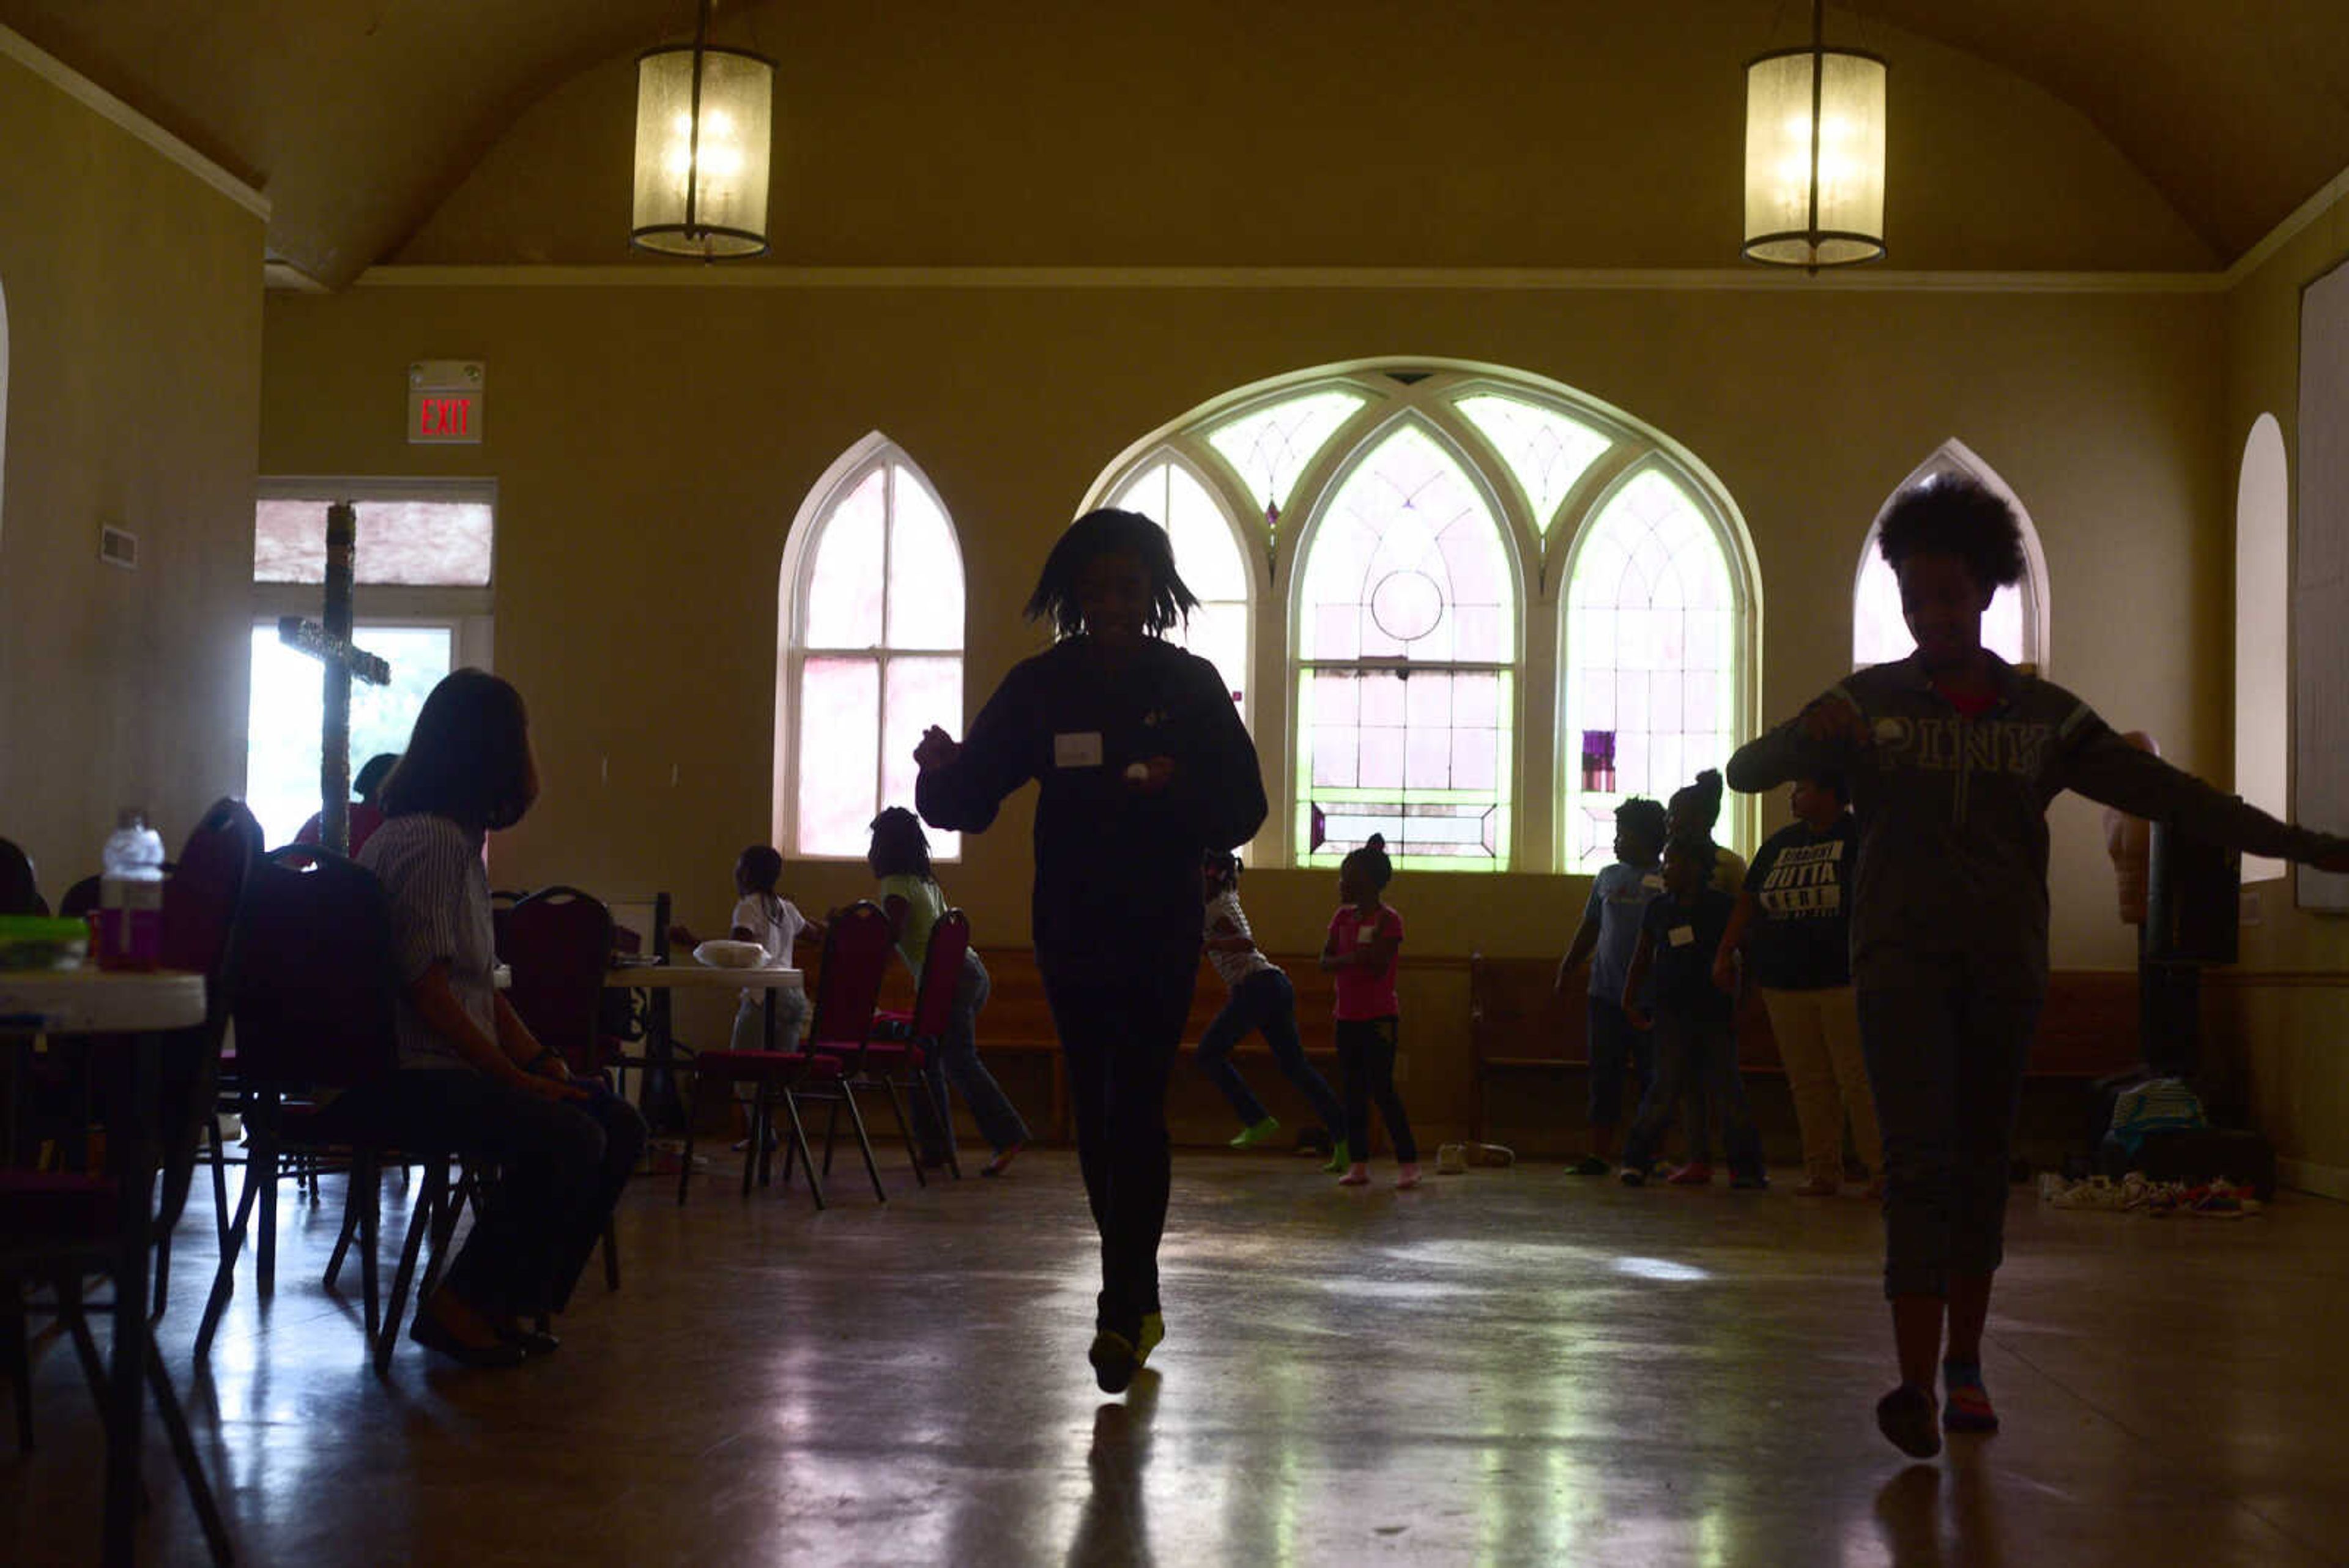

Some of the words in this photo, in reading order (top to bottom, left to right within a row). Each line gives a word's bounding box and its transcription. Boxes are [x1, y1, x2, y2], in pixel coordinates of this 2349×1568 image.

[421, 399, 470, 436] EXIT
[1871, 716, 2051, 775] PINK
[1762, 860, 1836, 890] OUTTA
